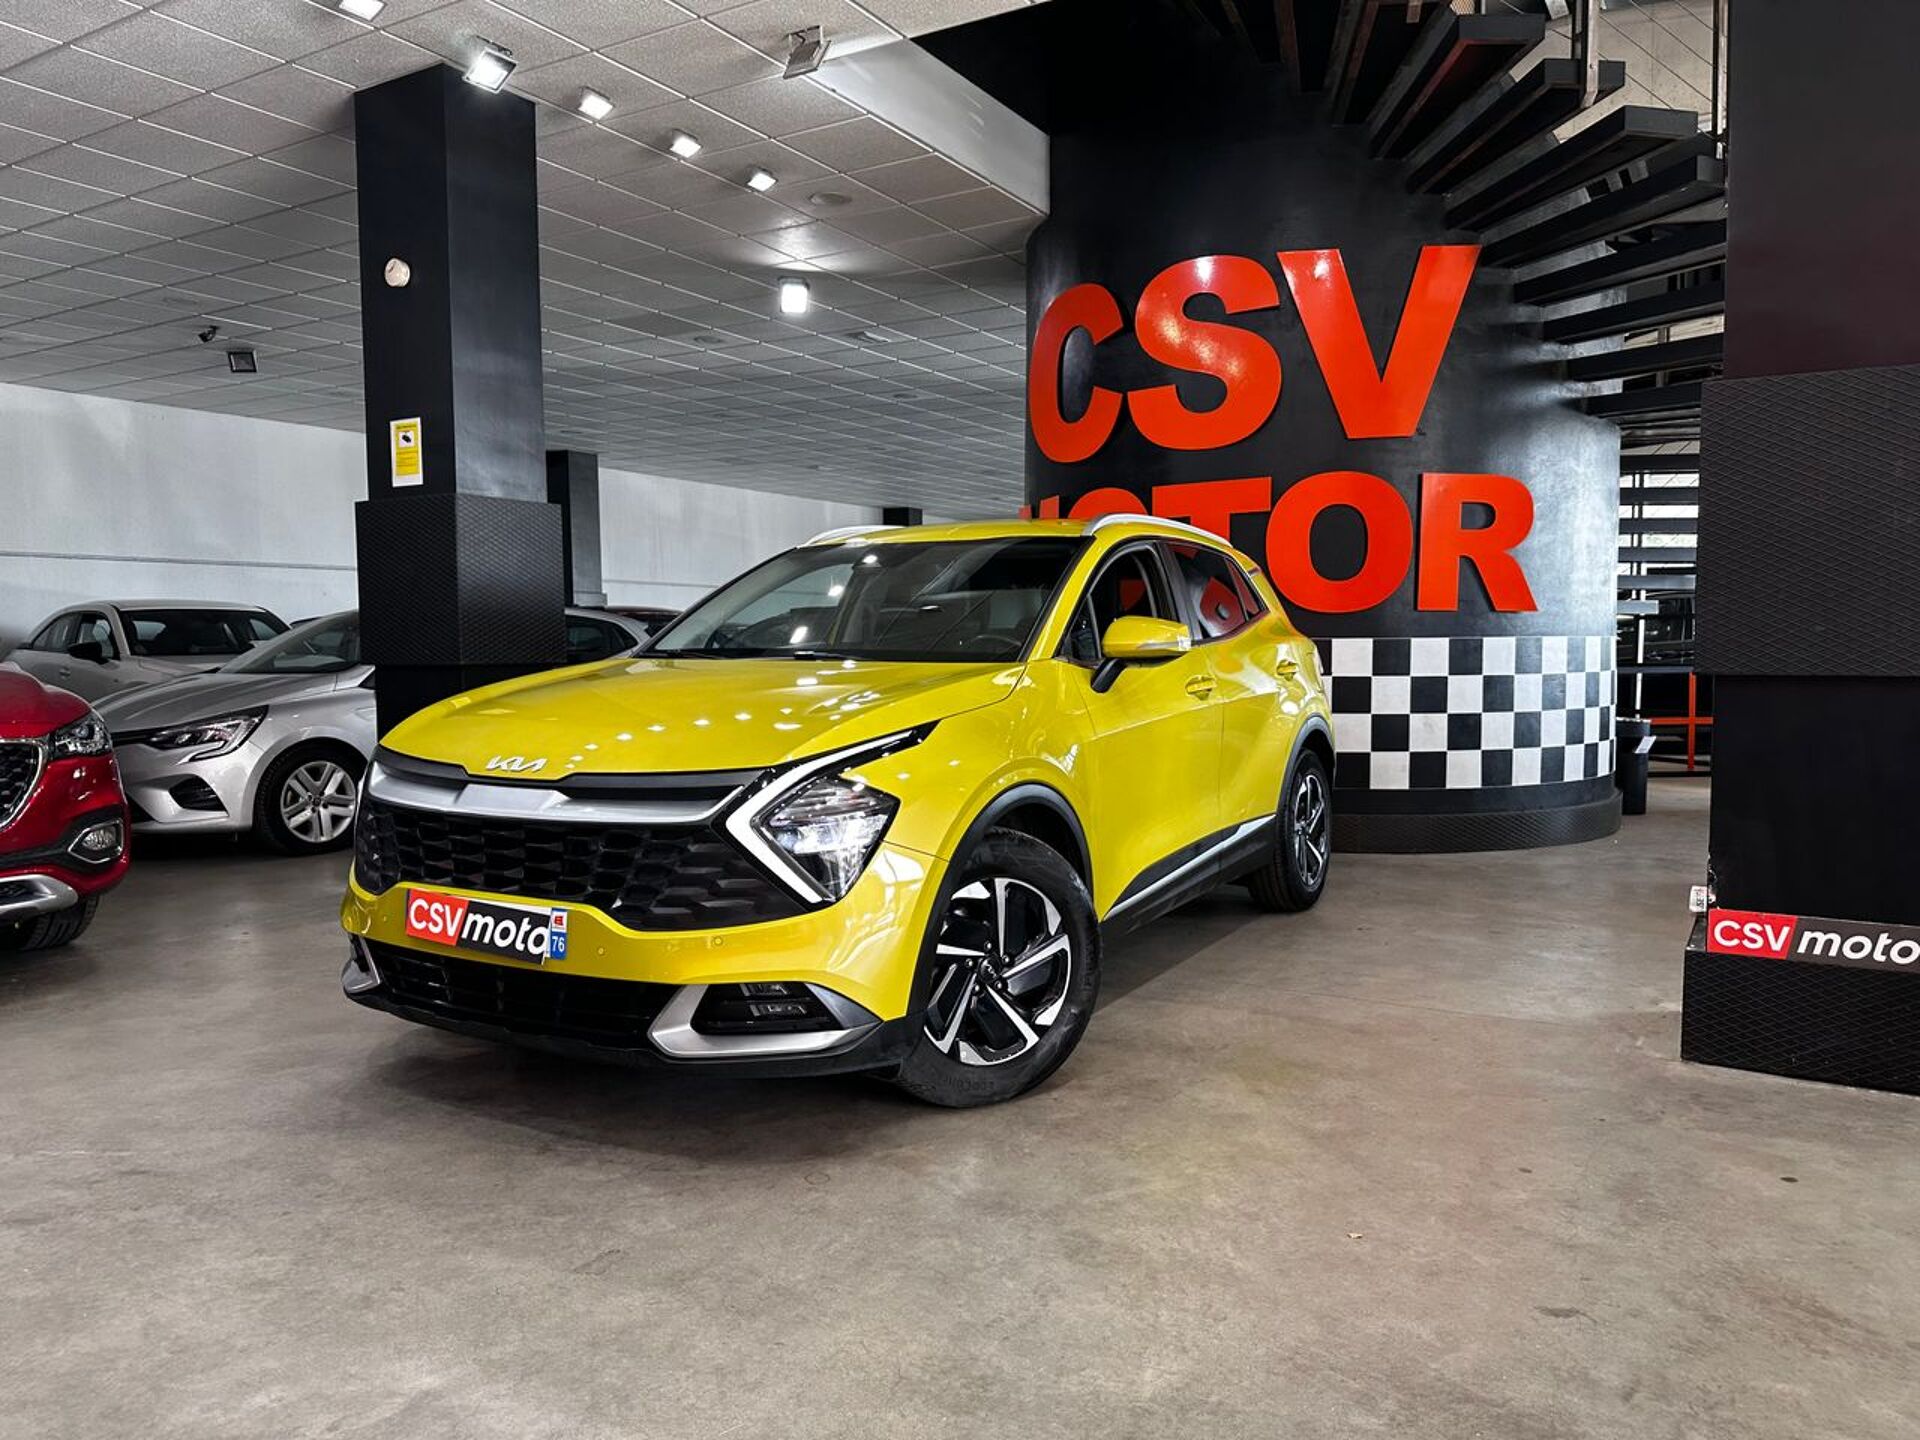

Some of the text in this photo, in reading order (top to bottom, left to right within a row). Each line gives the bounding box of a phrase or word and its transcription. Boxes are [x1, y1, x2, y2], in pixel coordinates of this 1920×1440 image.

[1029, 244, 1483, 463] CSV
[1018, 470, 1539, 613] TOR
[485, 755, 548, 772] KIA
[551, 935, 565, 953] 76
